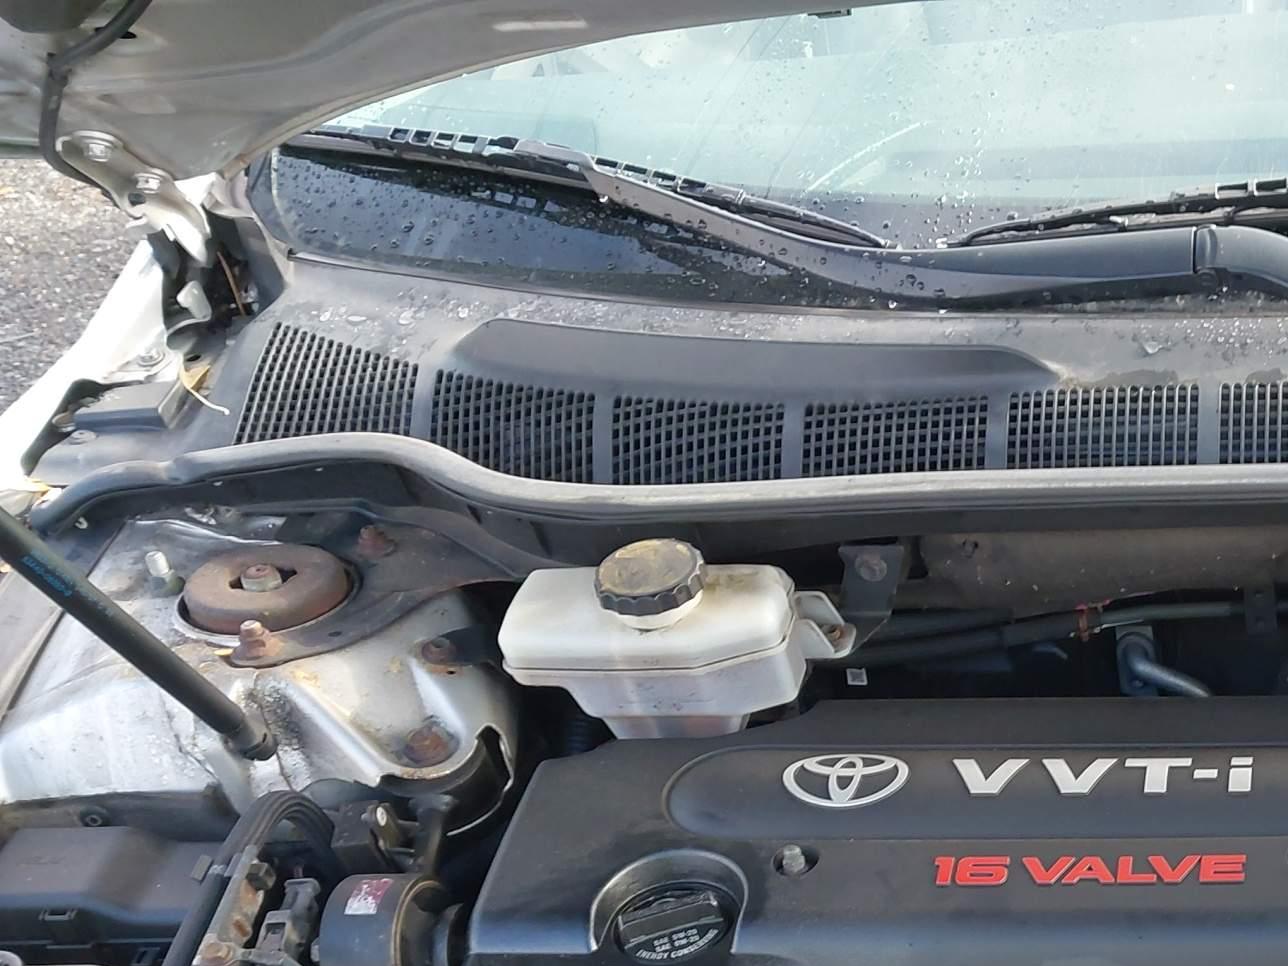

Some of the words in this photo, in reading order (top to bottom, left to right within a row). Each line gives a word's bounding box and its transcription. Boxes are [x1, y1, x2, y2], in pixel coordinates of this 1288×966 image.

[953, 757, 1253, 794] VVT-i
[934, 856, 1011, 885] 16
[1022, 854, 1247, 884] VALVE
